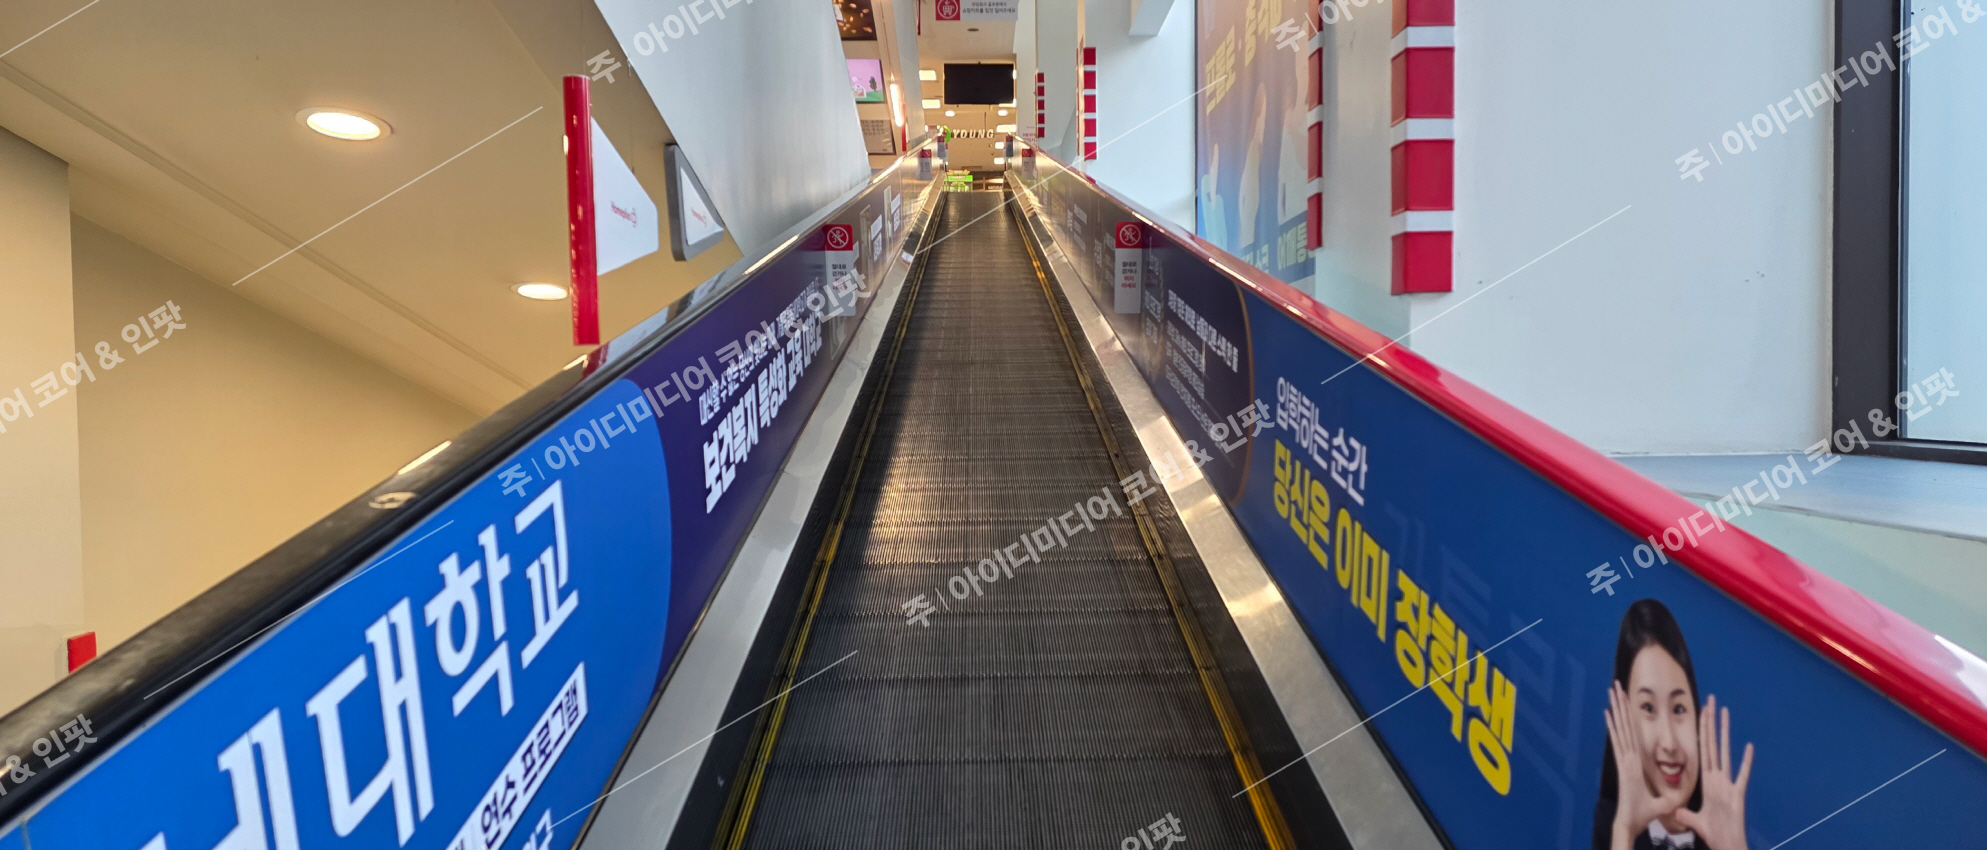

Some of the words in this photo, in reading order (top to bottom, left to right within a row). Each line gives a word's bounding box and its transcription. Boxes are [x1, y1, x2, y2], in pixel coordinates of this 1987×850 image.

[952, 129, 994, 138] YOUNG
[703, 382, 759, 514] 보건복지
[757, 347, 787, 428] 특성화
[786, 328, 804, 392] 교육
[1276, 376, 1329, 470] 입학하는
[1331, 427, 1367, 507] 순간
[1273, 439, 1330, 571] 당신은
[1335, 507, 1390, 643] 이미
[1394, 567, 1517, 795] 장학생
[481, 774, 518, 849] 연수
[521, 679, 579, 796] 프로그램
